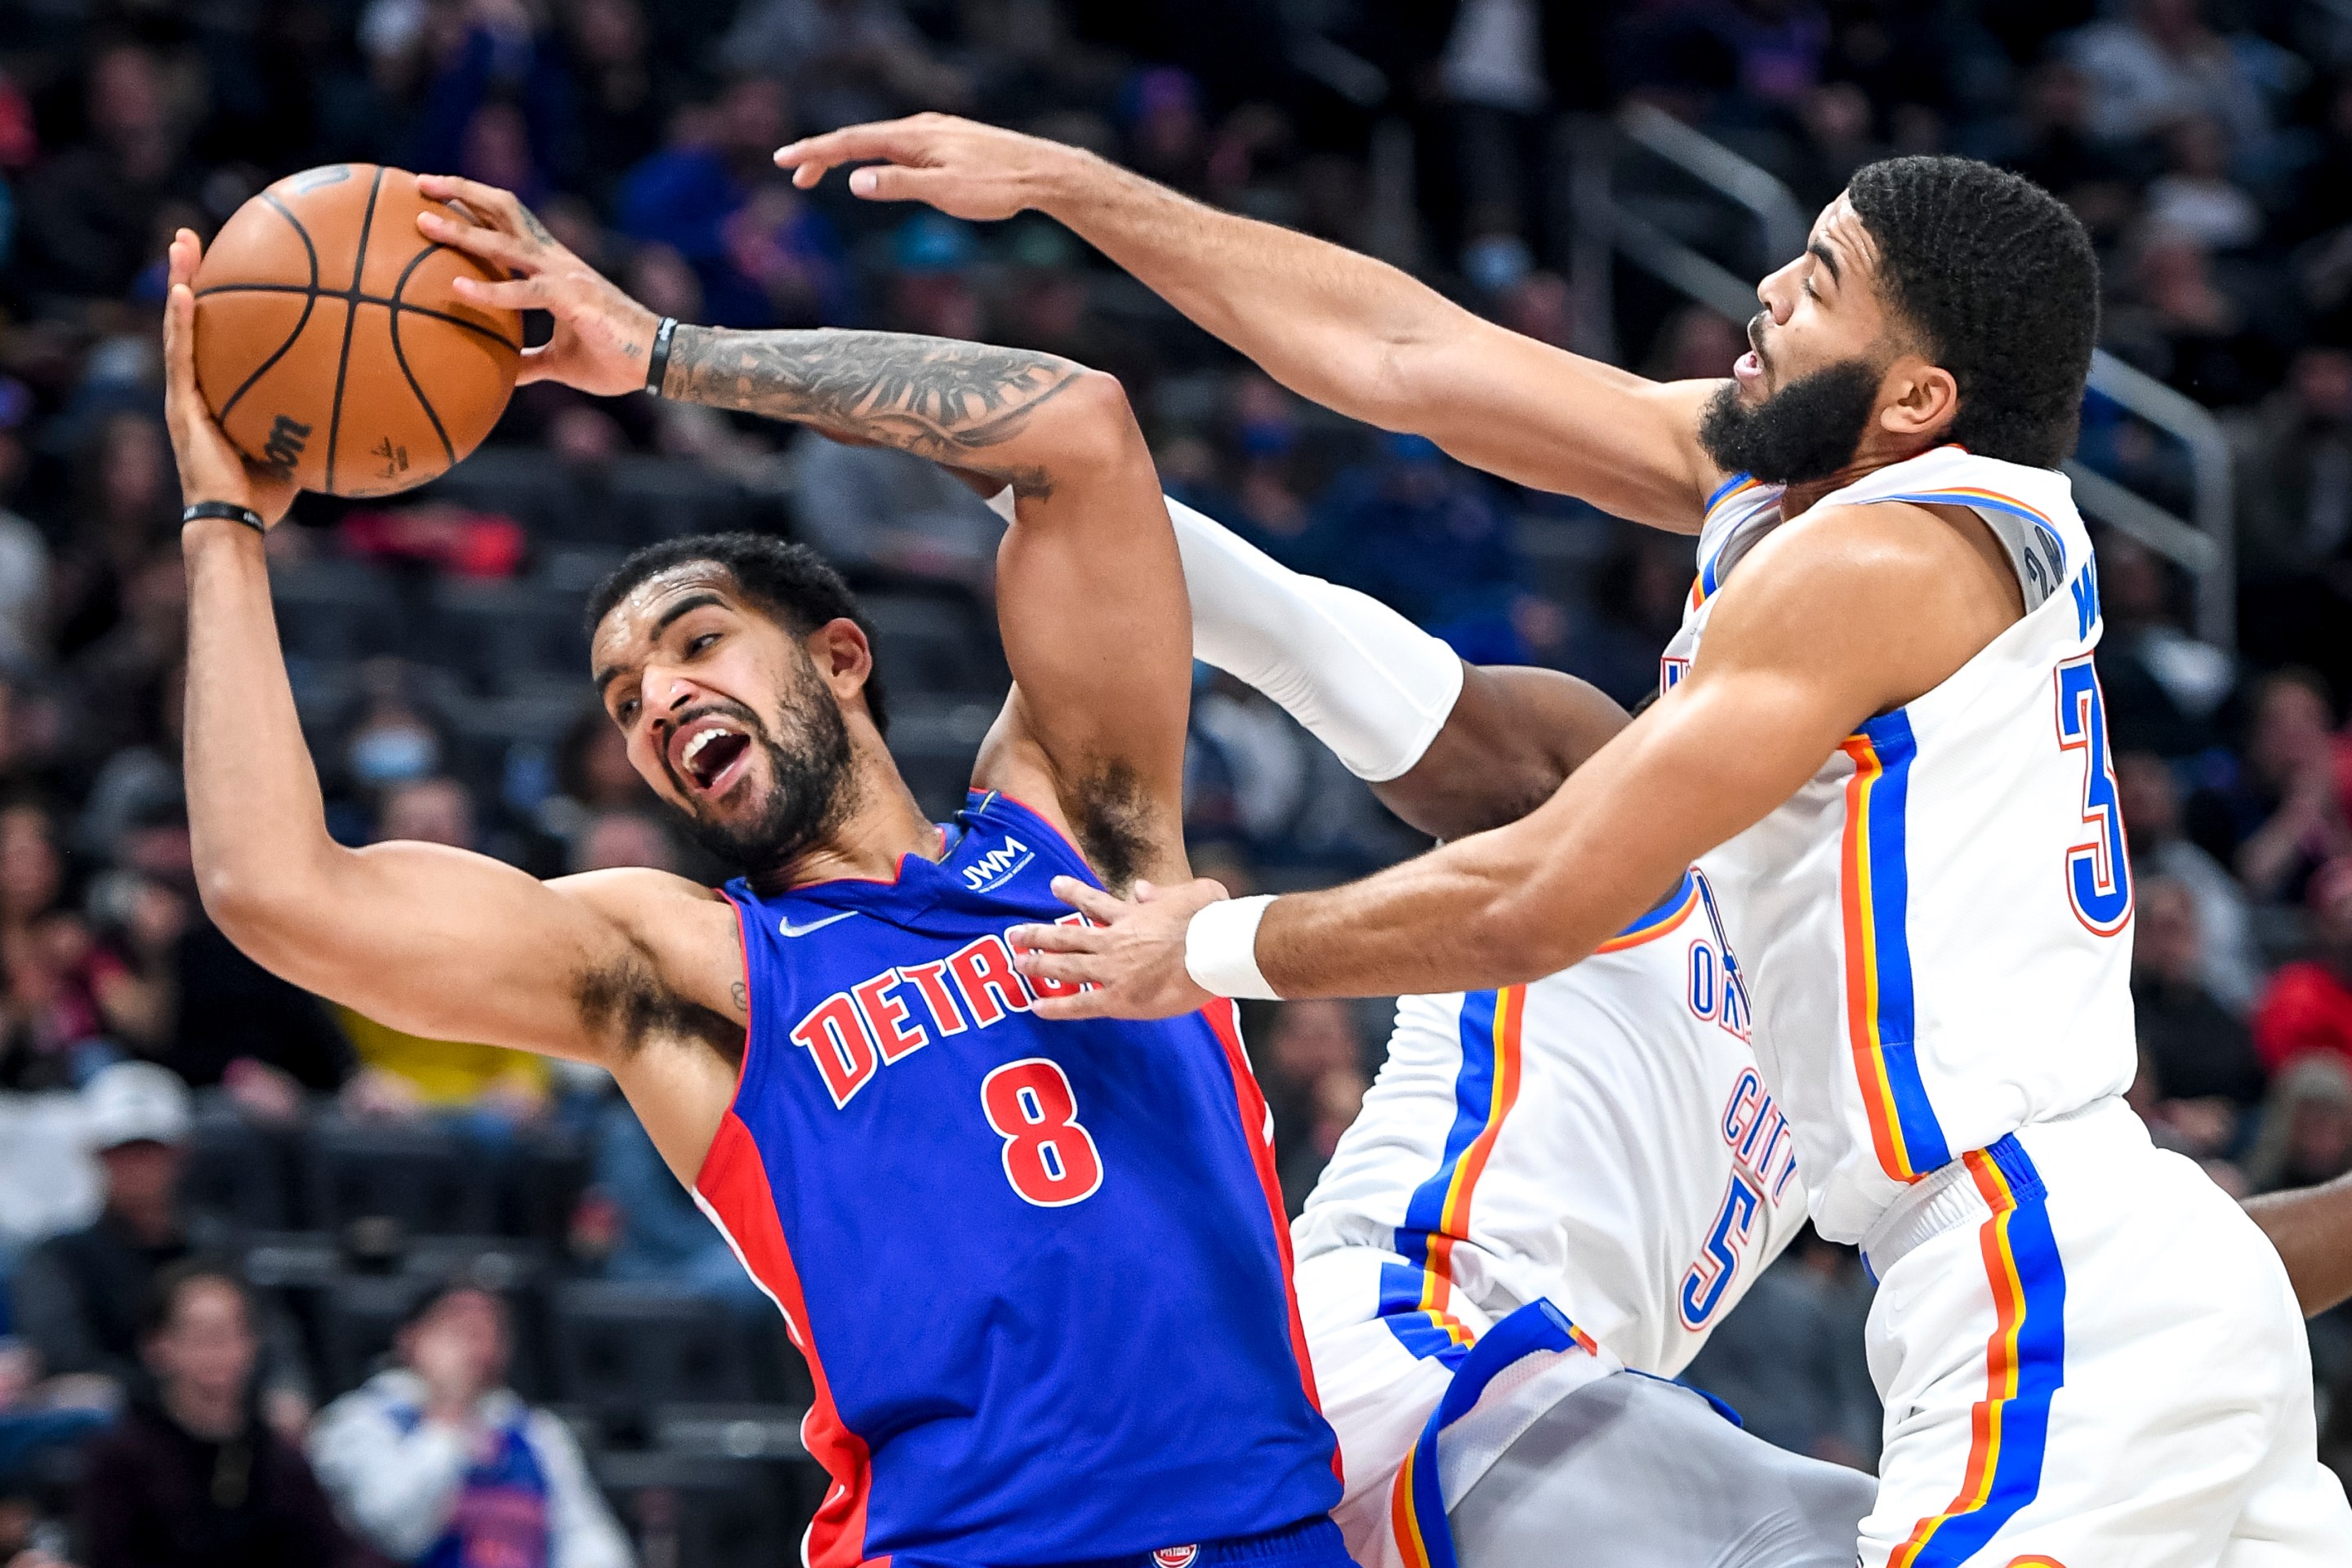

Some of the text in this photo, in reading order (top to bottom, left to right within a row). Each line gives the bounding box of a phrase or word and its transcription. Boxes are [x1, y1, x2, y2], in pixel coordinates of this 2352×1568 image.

[962, 835, 1028, 890] JWM
[980, 1058, 1104, 1208] 8
[1679, 1163, 1766, 1332] 5
